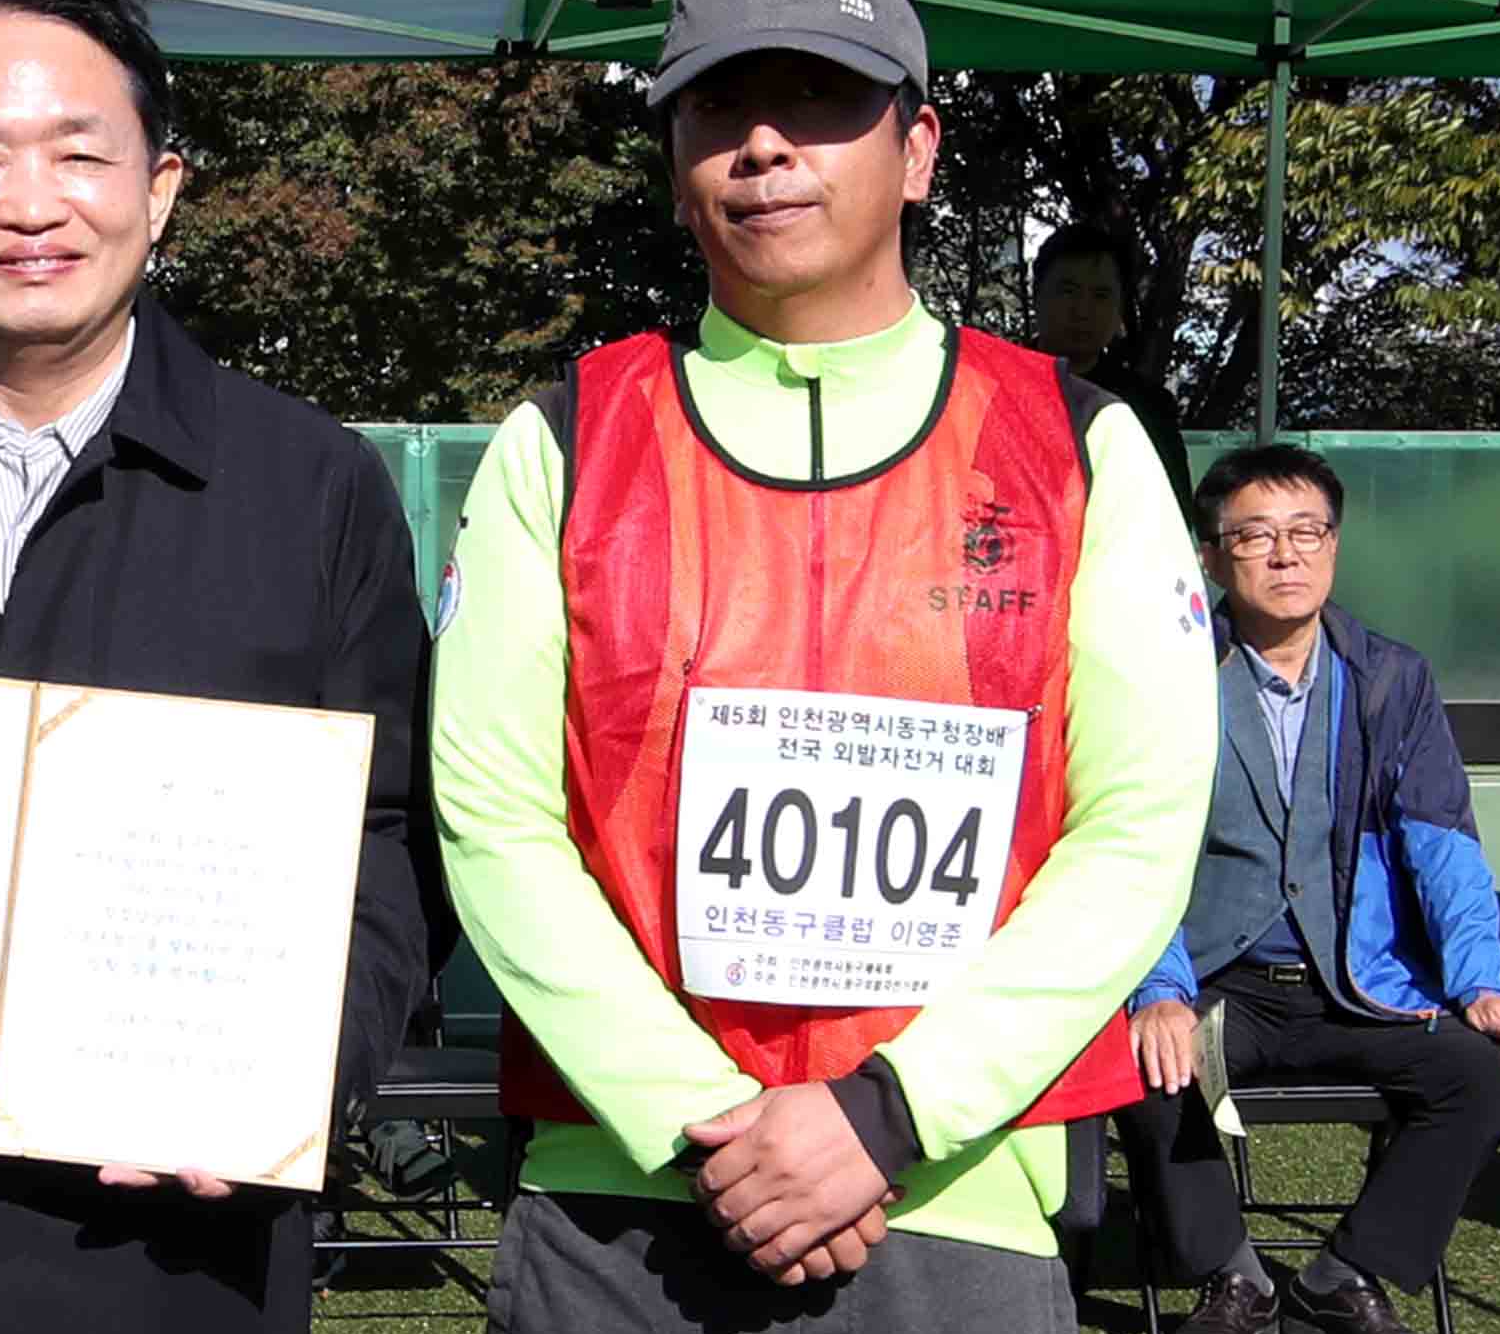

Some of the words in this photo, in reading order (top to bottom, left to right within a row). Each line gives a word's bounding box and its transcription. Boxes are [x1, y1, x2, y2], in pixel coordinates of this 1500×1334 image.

[927, 585, 1038, 617] STAFF
[709, 703, 768, 727] 제5회
[779, 705, 1007, 748] 인천광역시동구청장배
[777, 736, 823, 762] 전국
[834, 741, 945, 773] 외발자전거
[954, 751, 997, 777] 대회
[699, 786, 984, 907] 40104
[705, 905, 875, 945] 인천동구클럽
